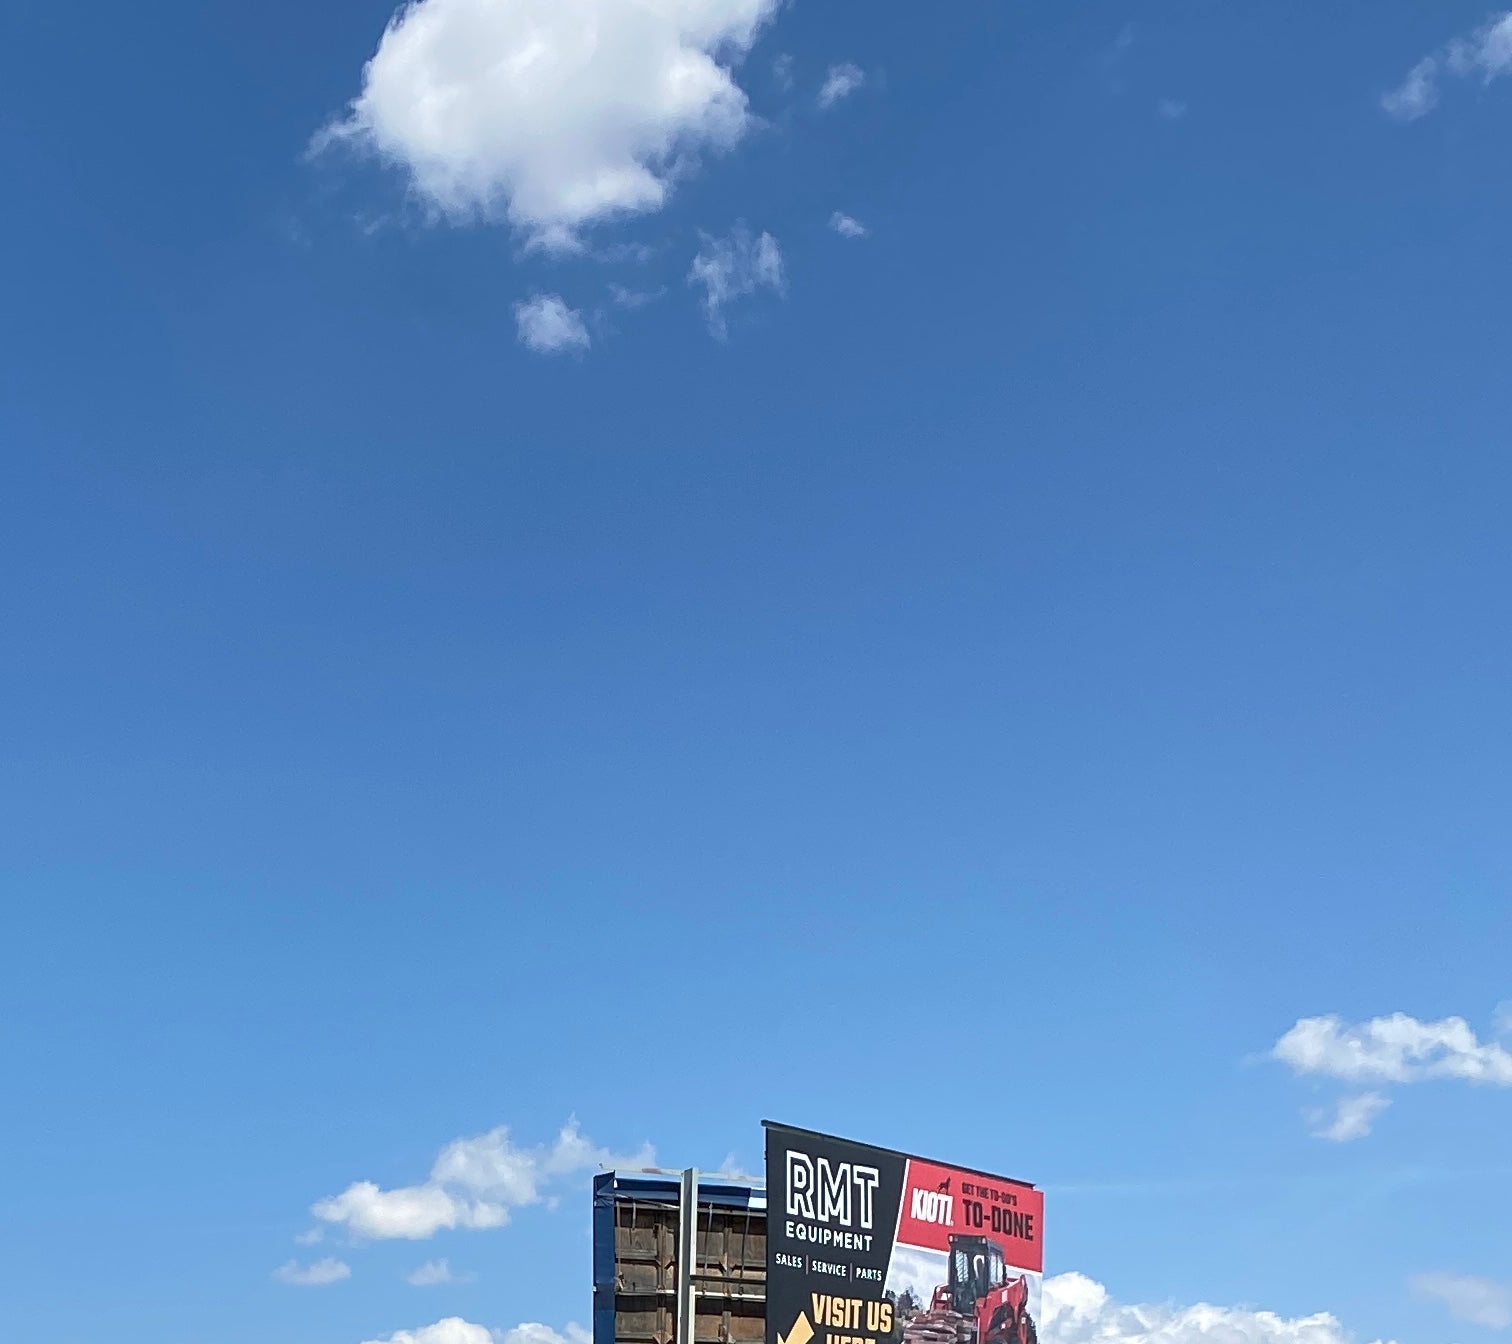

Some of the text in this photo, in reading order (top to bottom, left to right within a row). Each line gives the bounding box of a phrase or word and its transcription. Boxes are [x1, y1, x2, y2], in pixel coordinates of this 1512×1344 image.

[786, 1150, 879, 1229] RMT
[911, 1187, 952, 1226] KIOTI
[786, 1221, 873, 1251] EQUIPMENT
[962, 1199, 1033, 1240] TO-DONE
[775, 1252, 882, 1281] SALES SERVICE PARTS
[811, 1292, 893, 1333] VISIT US
